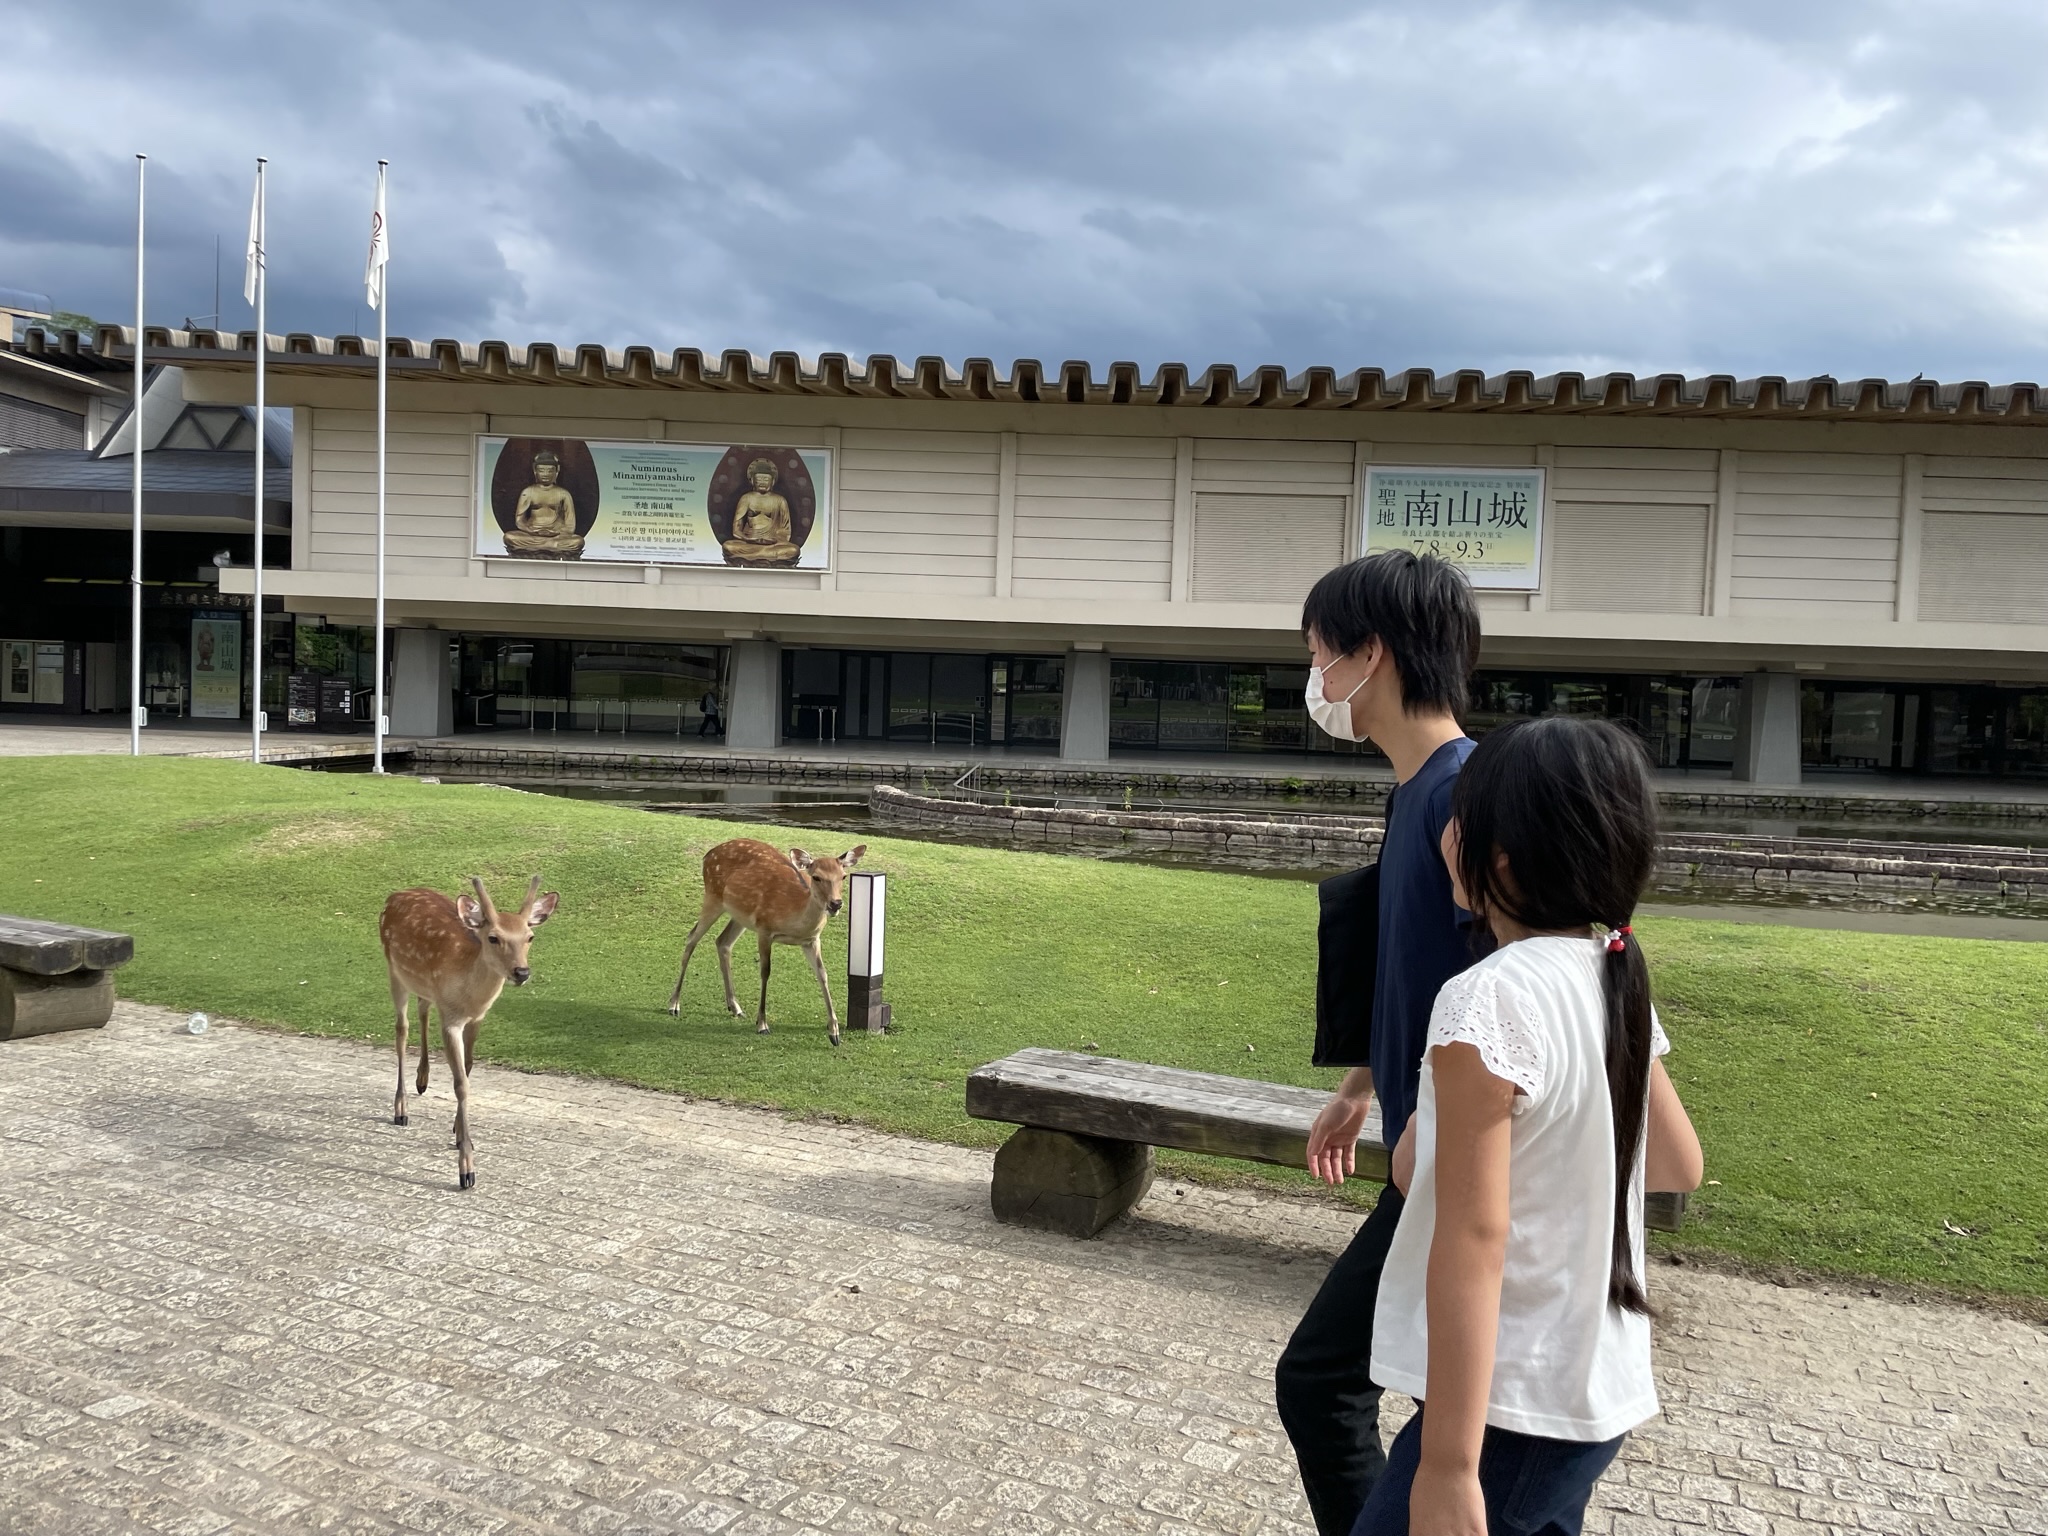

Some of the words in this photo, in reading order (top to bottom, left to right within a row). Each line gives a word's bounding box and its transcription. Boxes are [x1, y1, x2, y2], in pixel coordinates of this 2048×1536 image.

[631, 465, 677, 473] Numinous
[612, 472, 695, 482] Minamiyamashiro
[651, 502, 673, 510] 南山城
[1376, 488, 1396, 527] 聖地
[1404, 489, 1529, 529] 南山城
[611, 526, 638, 534] 성스러운
[220, 630, 235, 672] 南山城
